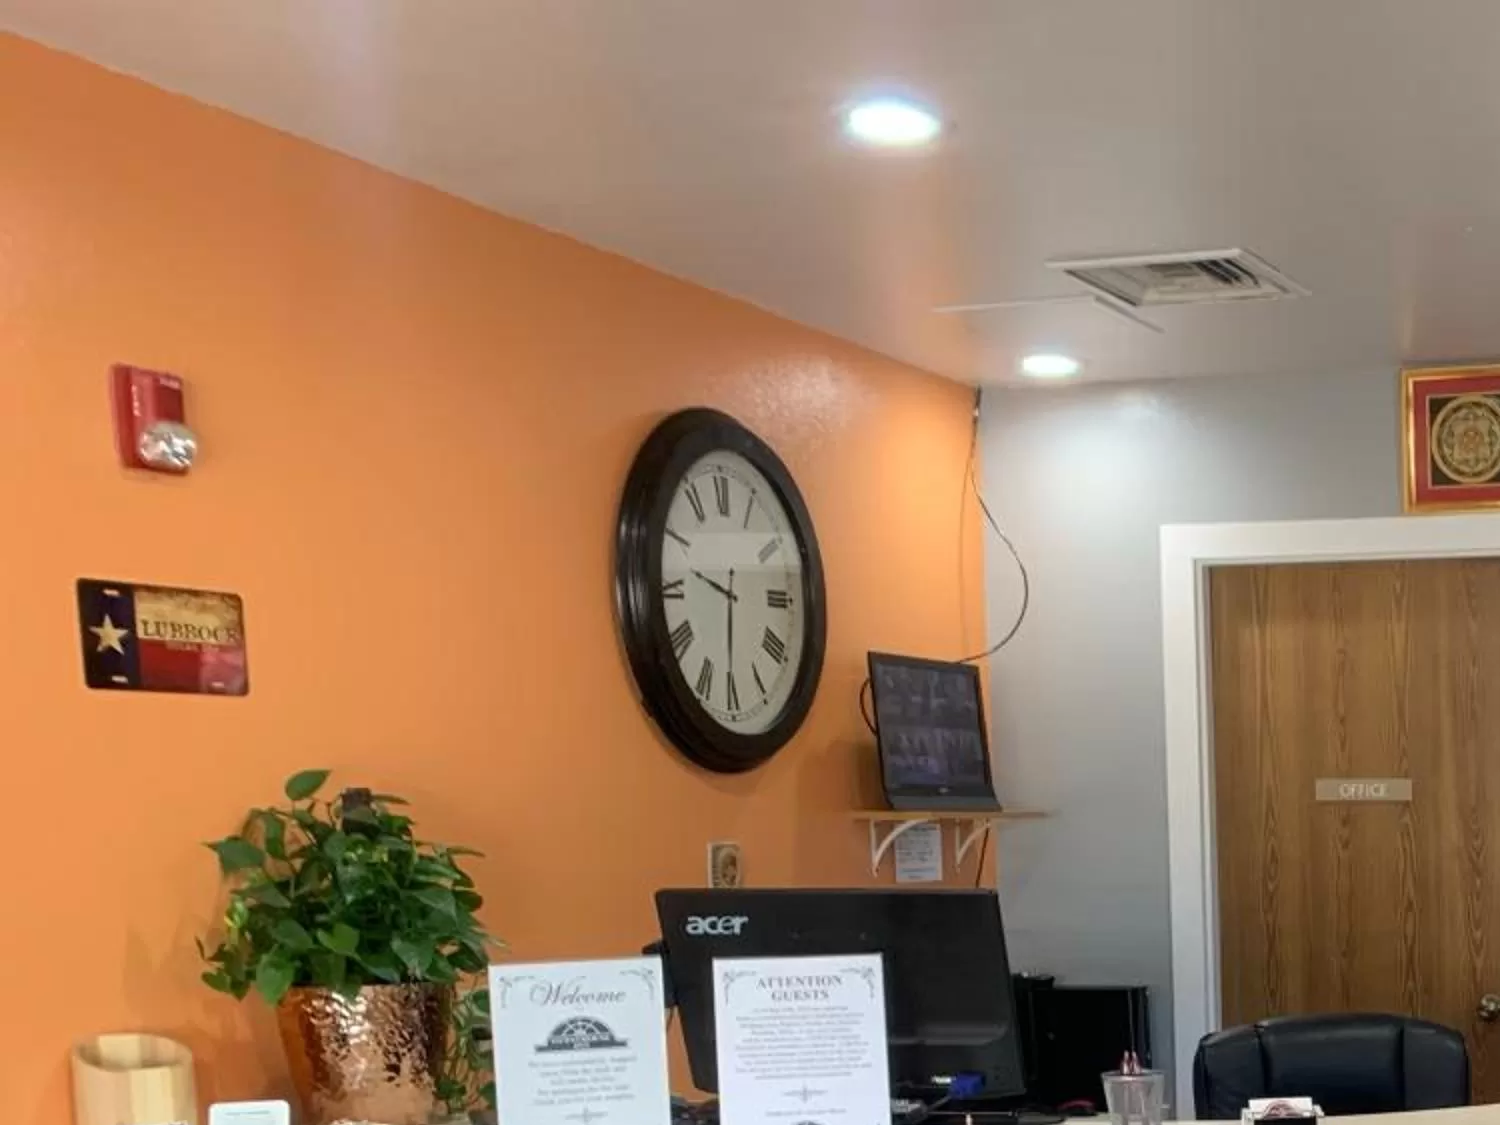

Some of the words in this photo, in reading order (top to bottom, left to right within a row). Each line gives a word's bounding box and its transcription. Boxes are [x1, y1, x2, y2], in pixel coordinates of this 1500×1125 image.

[141, 618, 238, 643] LUBBOCK
[1338, 783, 1387, 798] OFFICE
[685, 915, 749, 936] acer
[756, 974, 843, 990] ATTENTION
[529, 977, 627, 1006] Welcome
[771, 989, 830, 1002] GUESTS
